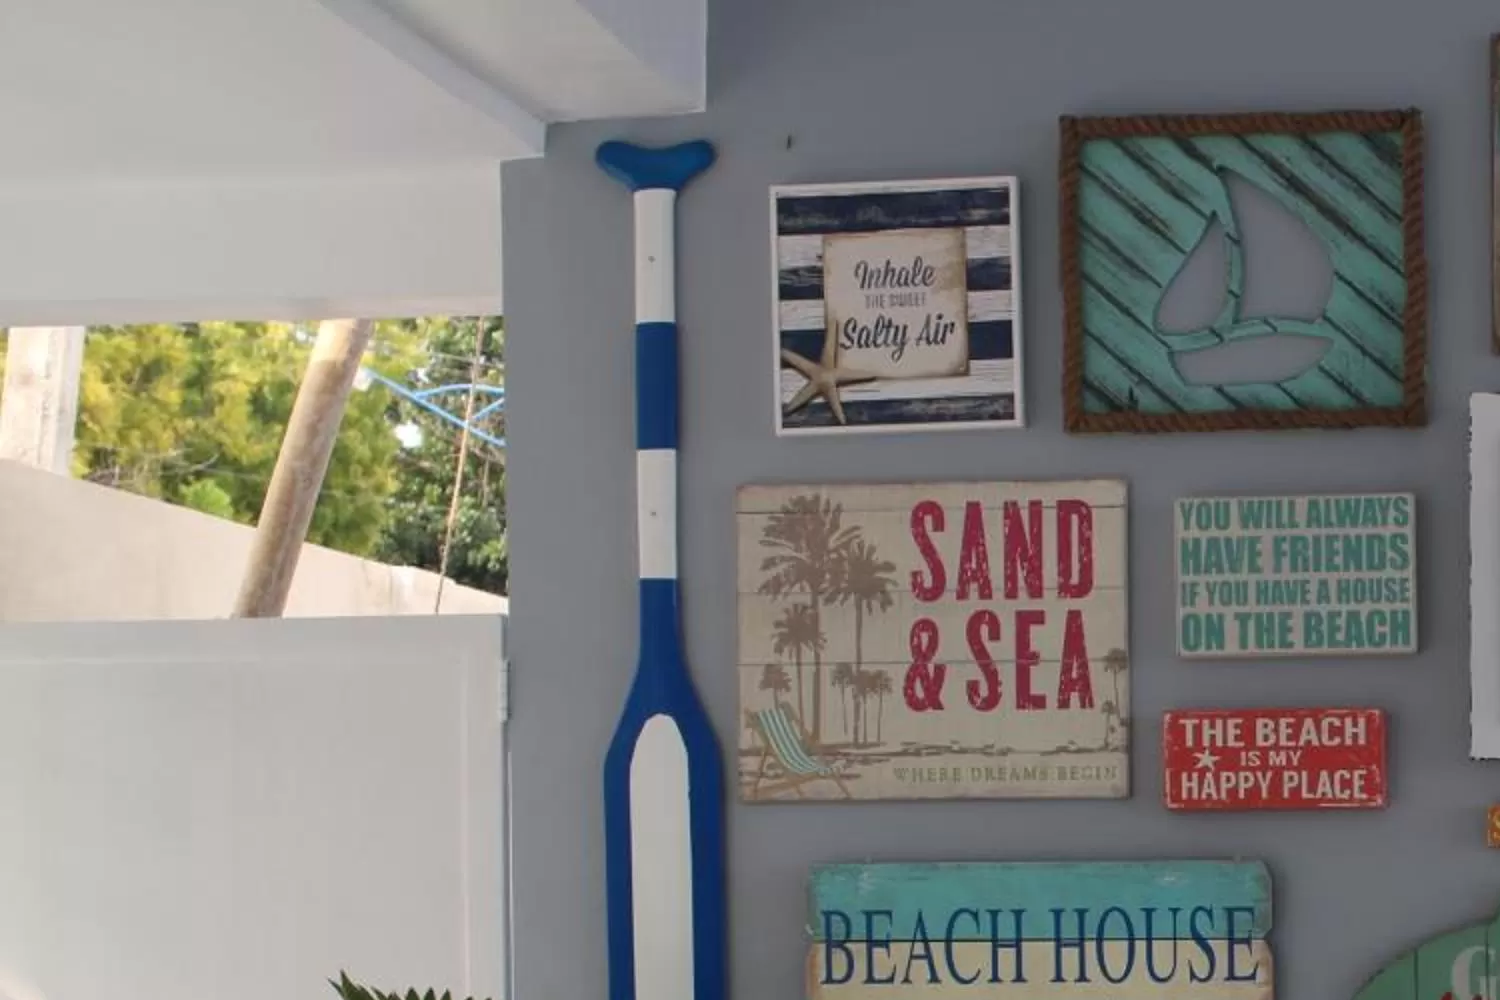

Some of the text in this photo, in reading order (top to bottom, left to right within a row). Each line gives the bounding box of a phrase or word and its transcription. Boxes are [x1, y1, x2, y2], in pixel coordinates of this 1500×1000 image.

[854, 256, 935, 289] Inhale
[839, 313, 955, 363] Salty Air
[1179, 496, 1410, 531] YOU WILL ALWAYS
[910, 499, 1094, 603] SAND
[1180, 533, 1410, 575] HAVE FRIENDS
[1181, 577, 1410, 608] IF YOU HAVE A HOUSE
[1181, 608, 1411, 652] ON THE BEACH
[904, 609, 1095, 712] & SEA
[1178, 716, 1367, 748] THE BEACH
[893, 765, 1118, 784] WHERE DREAMS BEGIN
[1240, 750, 1303, 767] IS MY
[1181, 769, 1369, 801] HAPPY PLACE
[820, 903, 1260, 986] BEACH HOUSE
